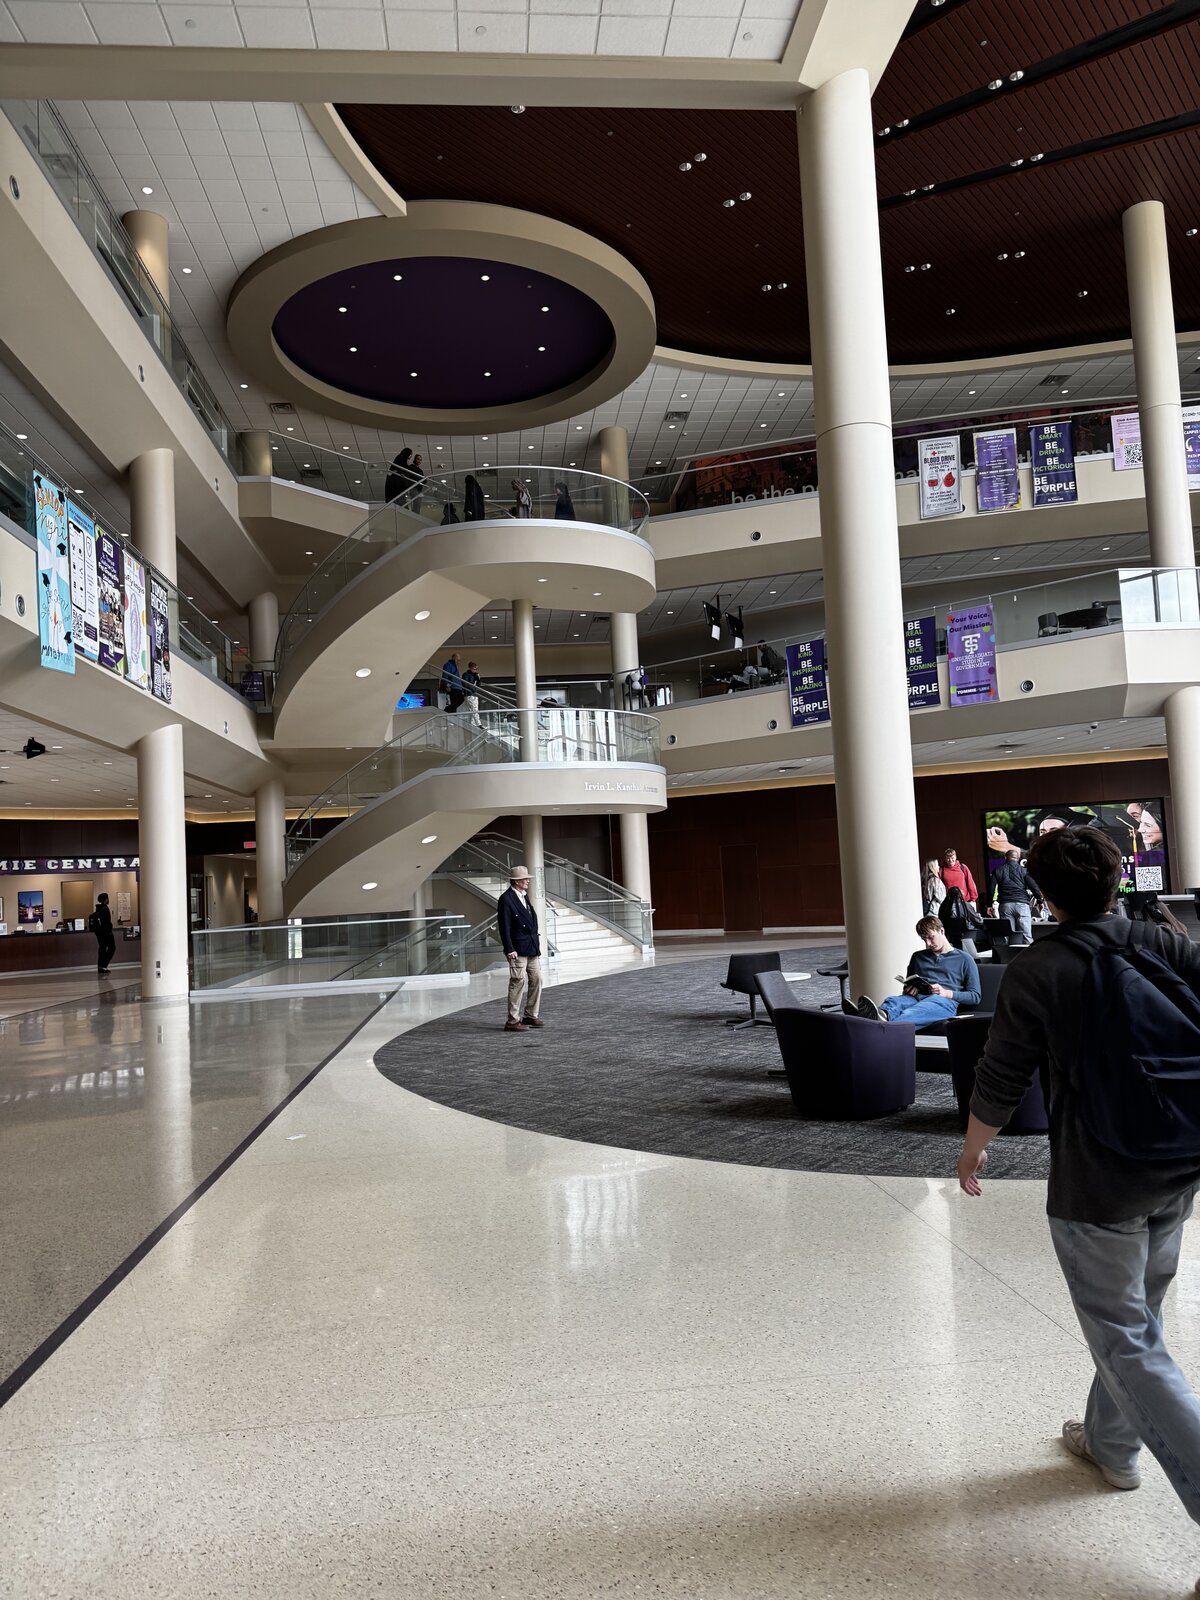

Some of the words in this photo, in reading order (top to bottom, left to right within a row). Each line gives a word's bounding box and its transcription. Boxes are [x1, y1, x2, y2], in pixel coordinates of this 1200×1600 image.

[1044, 426, 1056, 434] BE
[1039, 432, 1062, 440] SMART
[1045, 442, 1058, 450] BE
[1039, 448, 1064, 456] DRIVEN
[1046, 456, 1060, 466] BE
[1033, 463, 1074, 472] VICTORIOUS
[1034, 476, 1048, 486] BE
[732, 492, 756, 504] be
[762, 485, 796, 500] the
[950, 616, 966, 624] Your
[968, 612, 990, 620] Voice.
[908, 621, 920, 630] BE
[964, 622, 992, 630] Mission.
[906, 629, 924, 637] REAL
[800, 643, 811, 652] BE
[908, 638, 922, 648] BE
[798, 650, 814, 659] KIND
[906, 646, 924, 654] NICE
[910, 656, 922, 666] BE
[951, 651, 993, 662] UNDERGRADUATE
[800, 660, 812, 669] BE
[956, 661, 990, 672] GOVERNMENT
[961, 658, 984, 666] STUDENT
[792, 664, 822, 676] INSPIRING
[802, 676, 814, 685] BE
[794, 681, 822, 692] AMAZING
[907, 683, 938, 696] RPLE
[792, 696, 804, 706] BE
[584, 782, 604, 790] Irvin
[606, 782, 614, 790] L.
[616, 783, 642, 791] Kantha
